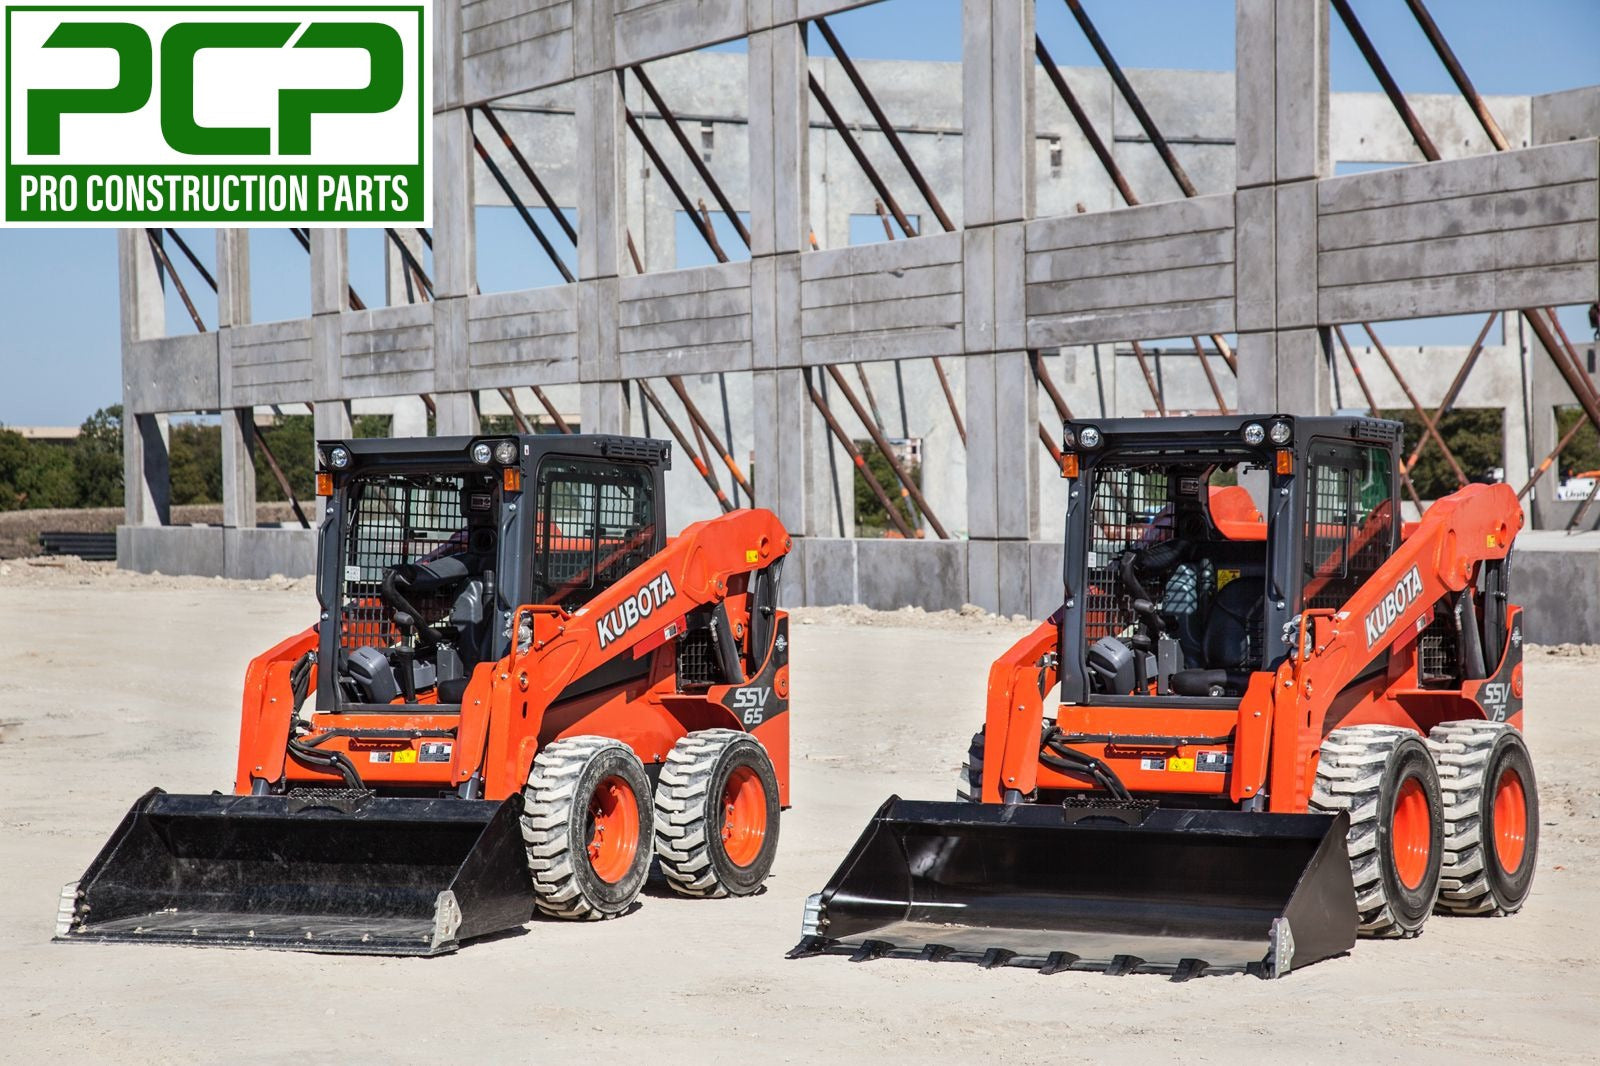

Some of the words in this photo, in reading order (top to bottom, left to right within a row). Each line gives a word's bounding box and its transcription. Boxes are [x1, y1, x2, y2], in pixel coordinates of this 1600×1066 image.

[597, 571, 675, 648] KUBOTA
[1365, 567, 1423, 648] KUBOTA
[732, 687, 771, 708] SSV
[1483, 683, 1511, 704] SSV
[743, 708, 763, 724] 65
[1492, 705, 1506, 722] 75
